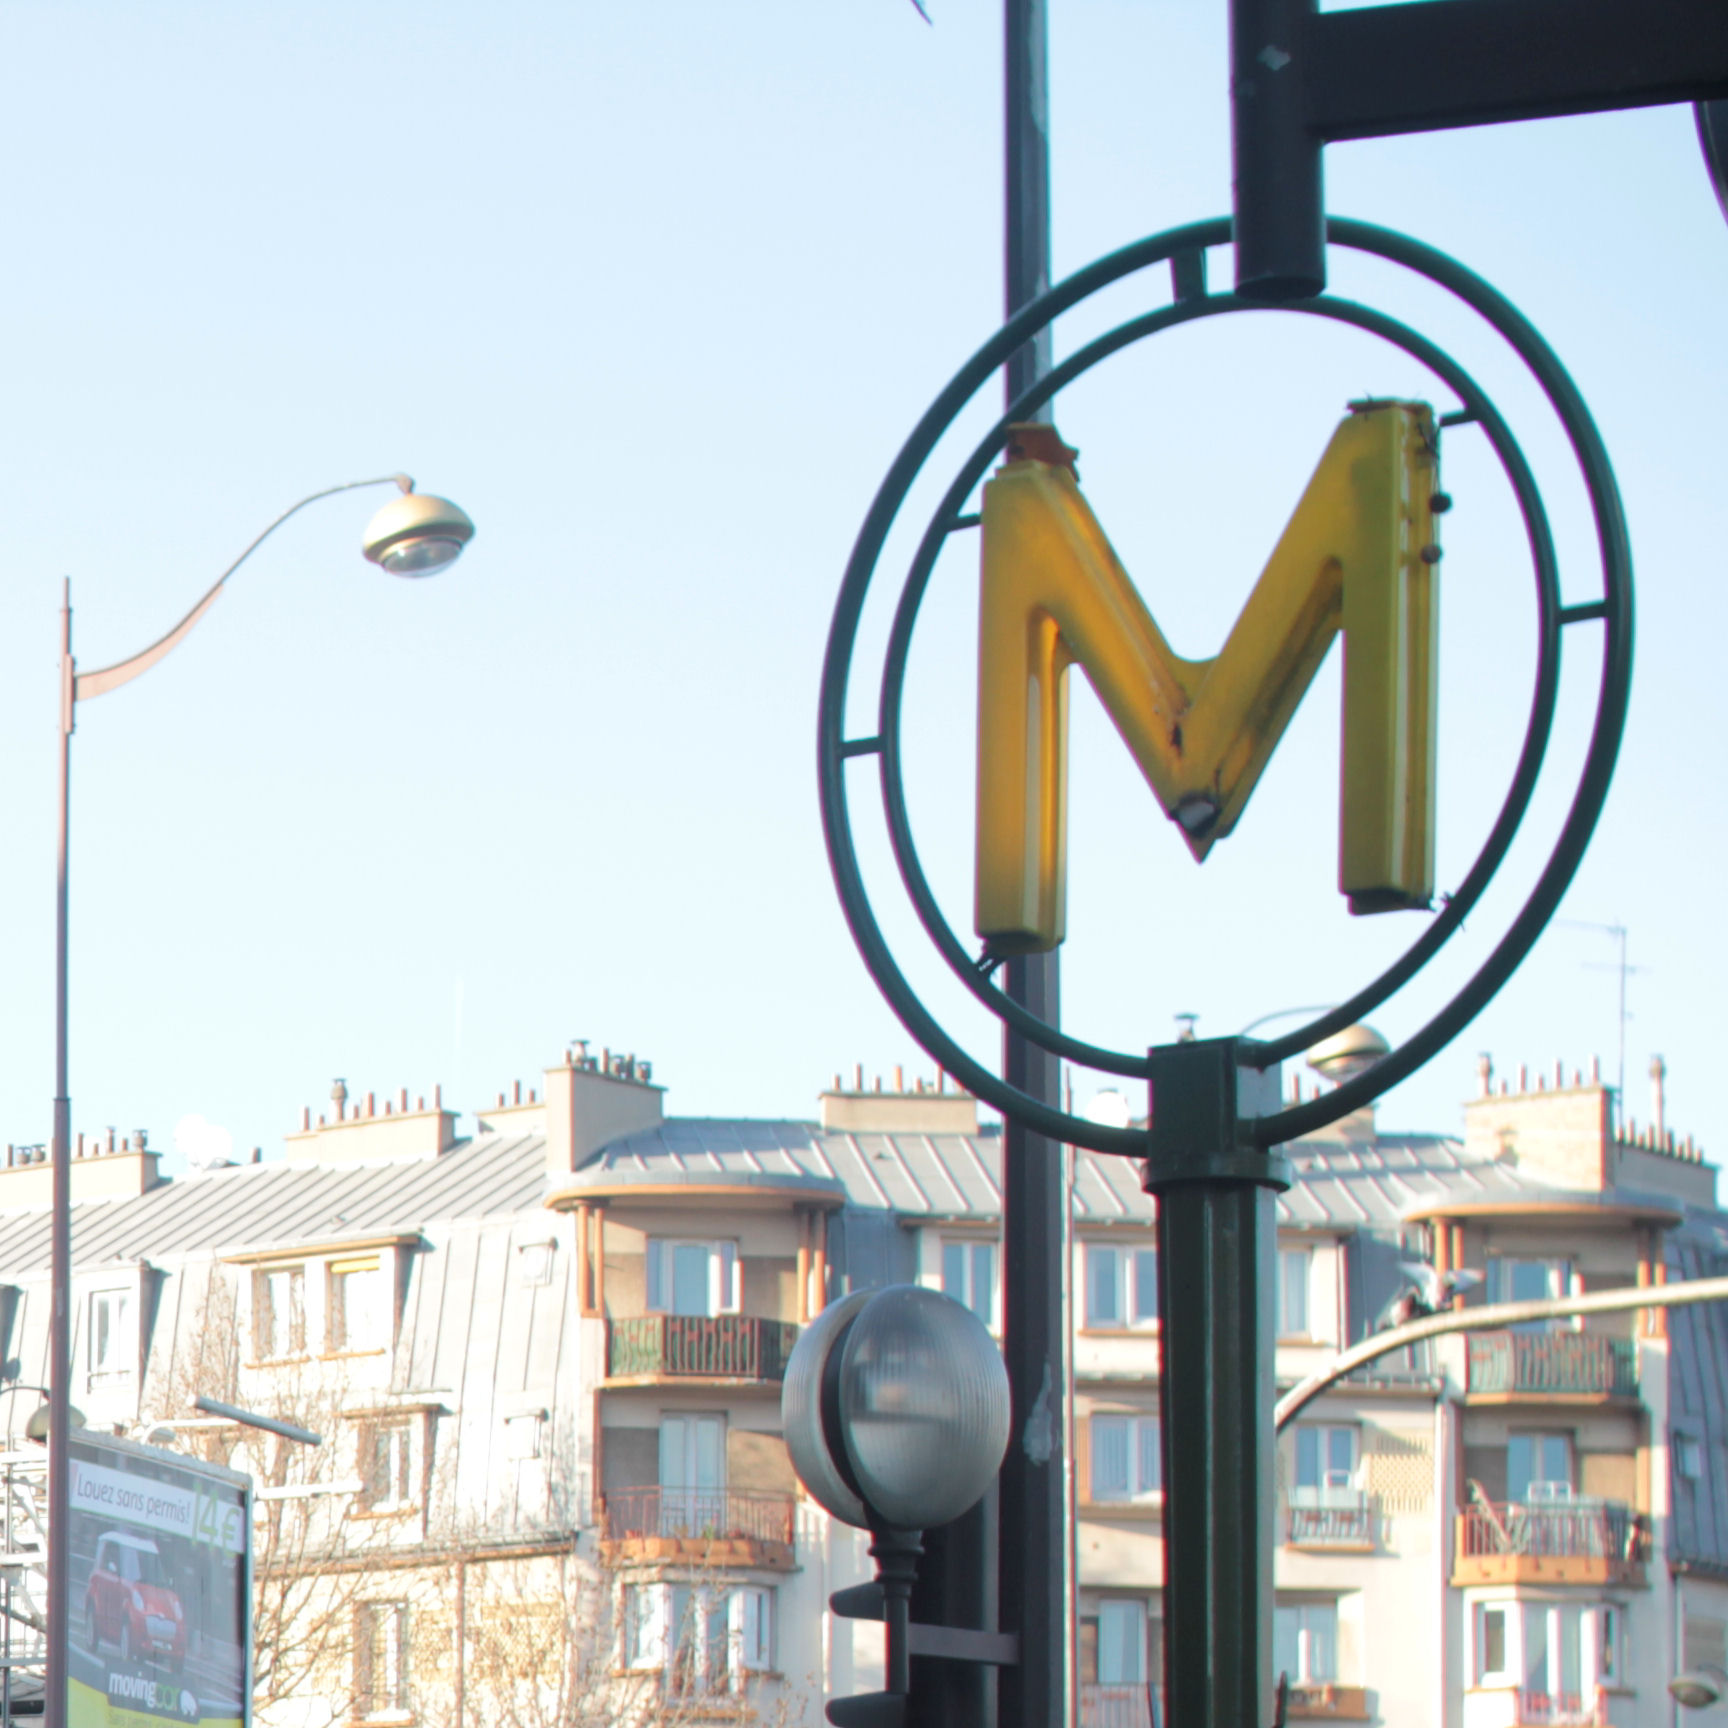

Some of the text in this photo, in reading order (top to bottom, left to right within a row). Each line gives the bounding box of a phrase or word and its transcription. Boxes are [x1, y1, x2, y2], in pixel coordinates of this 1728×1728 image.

[975, 398, 1441, 953] M
[76, 1472, 191, 1525] Louez sans permis!
